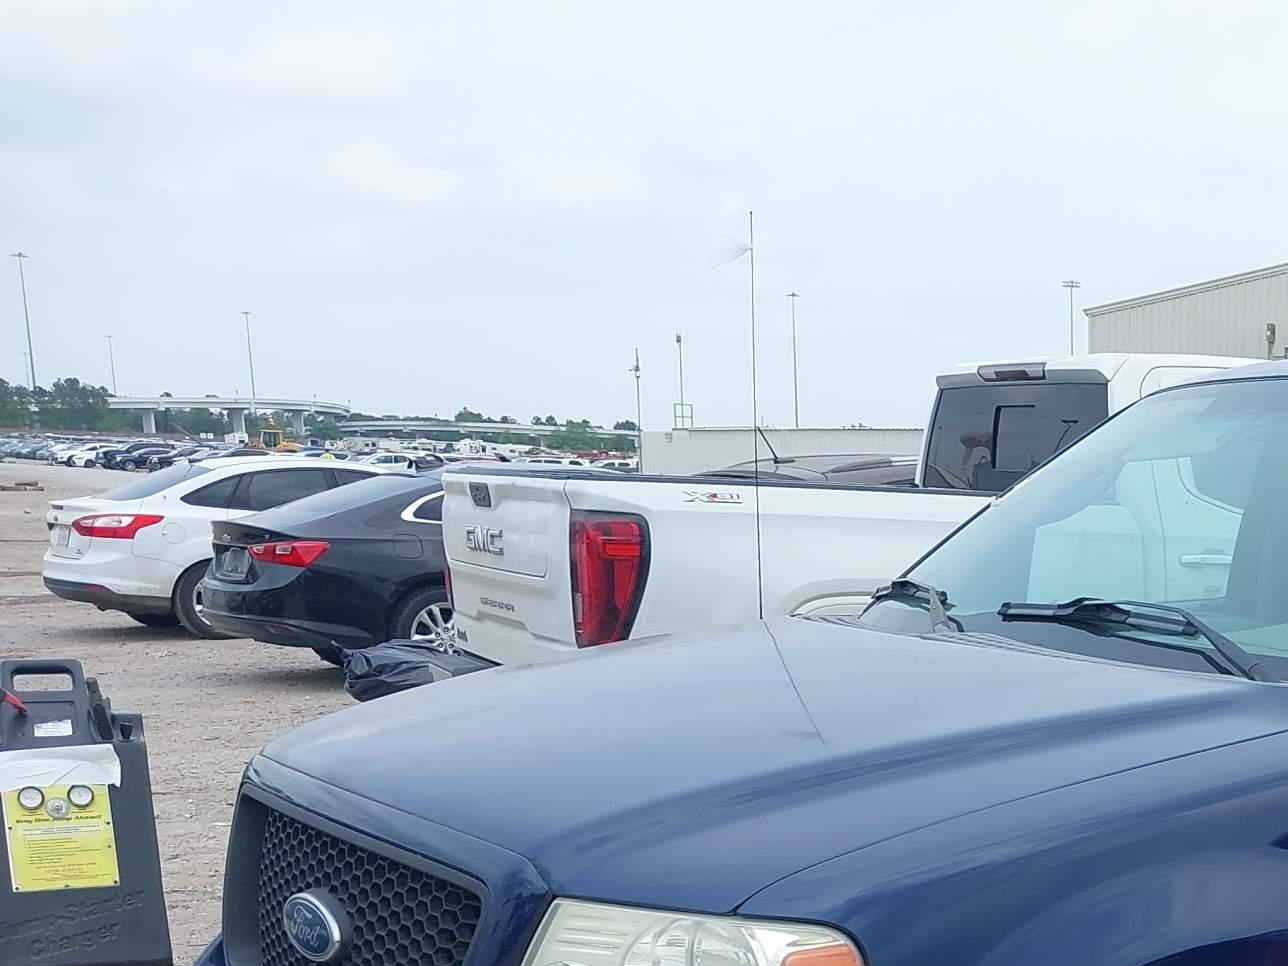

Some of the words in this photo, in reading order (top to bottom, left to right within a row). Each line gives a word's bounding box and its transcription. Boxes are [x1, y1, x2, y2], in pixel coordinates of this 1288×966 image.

[465, 525, 504, 556] GMC
[29, 922, 121, 961] Charger
[291, 905, 321, 948] Ford
